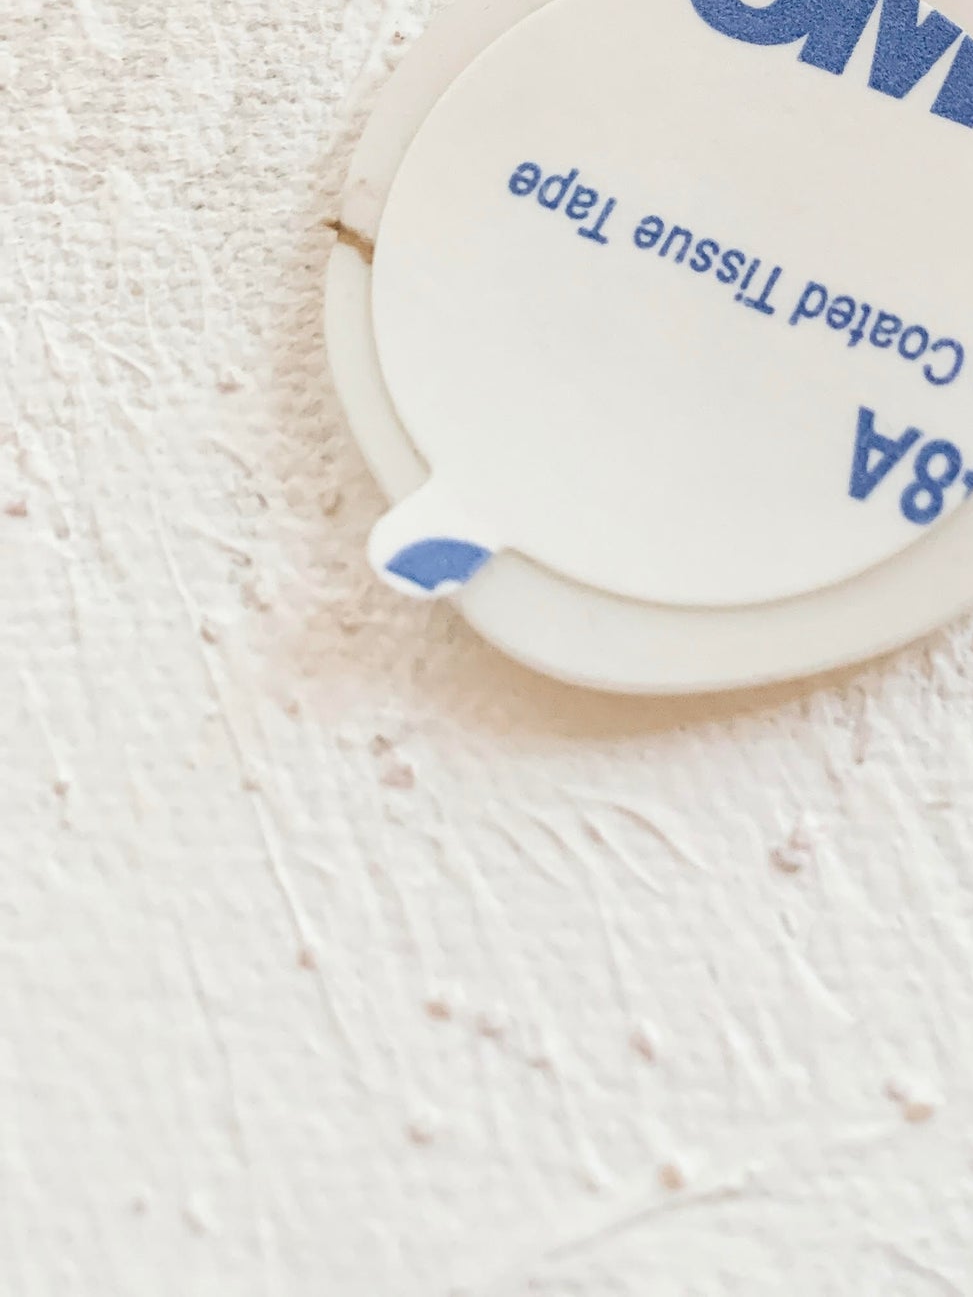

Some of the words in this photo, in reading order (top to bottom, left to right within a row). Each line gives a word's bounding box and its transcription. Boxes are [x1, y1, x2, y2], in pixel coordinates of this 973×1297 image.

[508, 161, 616, 245] Tape
[632, 214, 783, 317] Tissue
[789, 281, 965, 386] Coated
